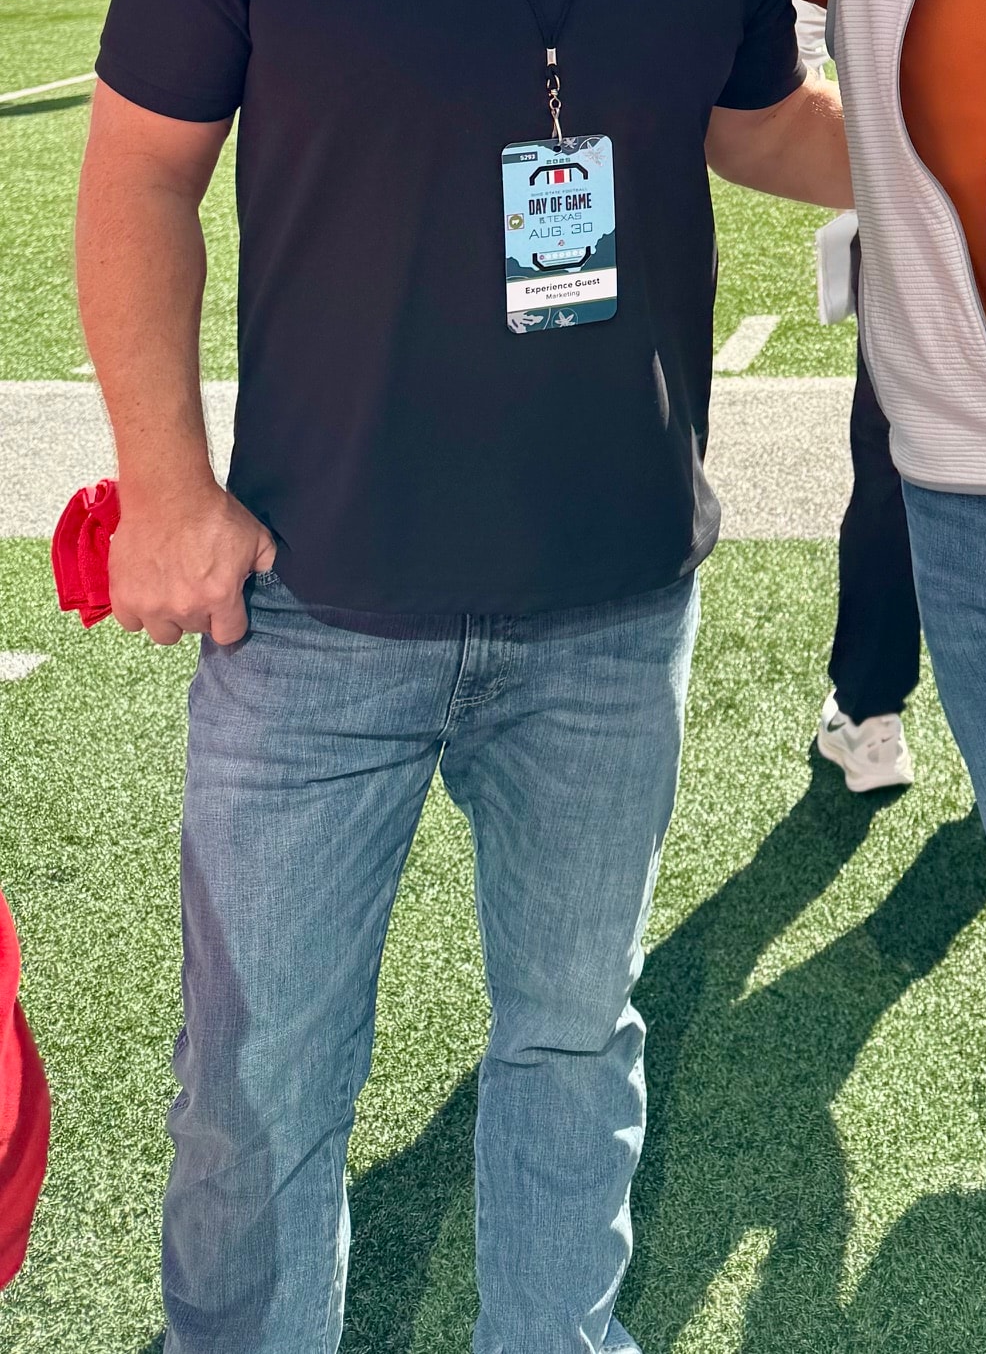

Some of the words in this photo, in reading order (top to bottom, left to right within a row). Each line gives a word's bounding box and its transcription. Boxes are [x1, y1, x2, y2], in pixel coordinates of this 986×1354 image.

[528, 197, 547, 215] DAY
[550, 196, 562, 213] OF
[565, 193, 592, 211] GAME
[547, 212, 582, 223] TEXAS
[529, 226, 565, 240] AUG.
[571, 222, 593, 235] 30
[525, 281, 573, 295] Experience
[575, 278, 600, 287] Guest
[546, 290, 581, 300] Marketing
